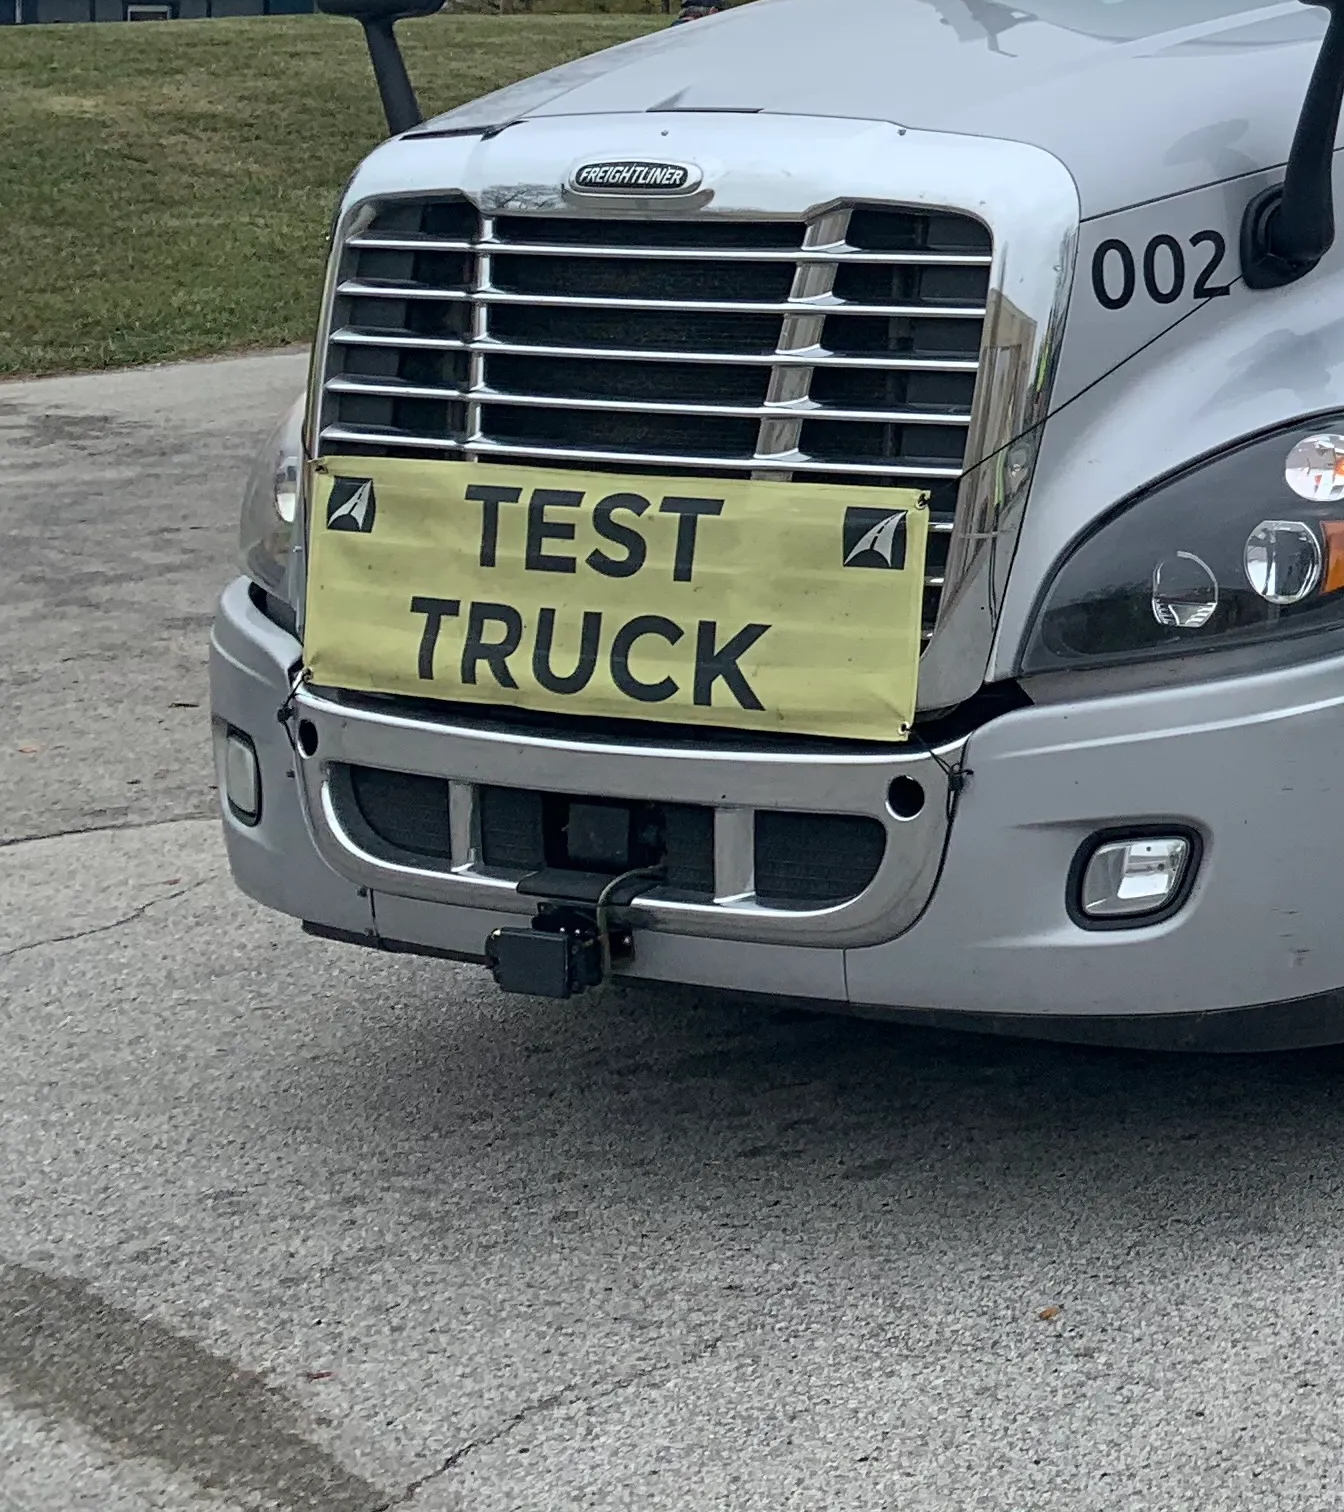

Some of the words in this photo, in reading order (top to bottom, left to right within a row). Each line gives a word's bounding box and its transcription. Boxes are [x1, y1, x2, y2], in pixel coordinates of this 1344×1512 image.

[579, 163, 684, 185] FREIGHTLINER
[1092, 230, 1230, 310] 002
[465, 484, 725, 582] TEST
[411, 596, 772, 712] TRUCK
